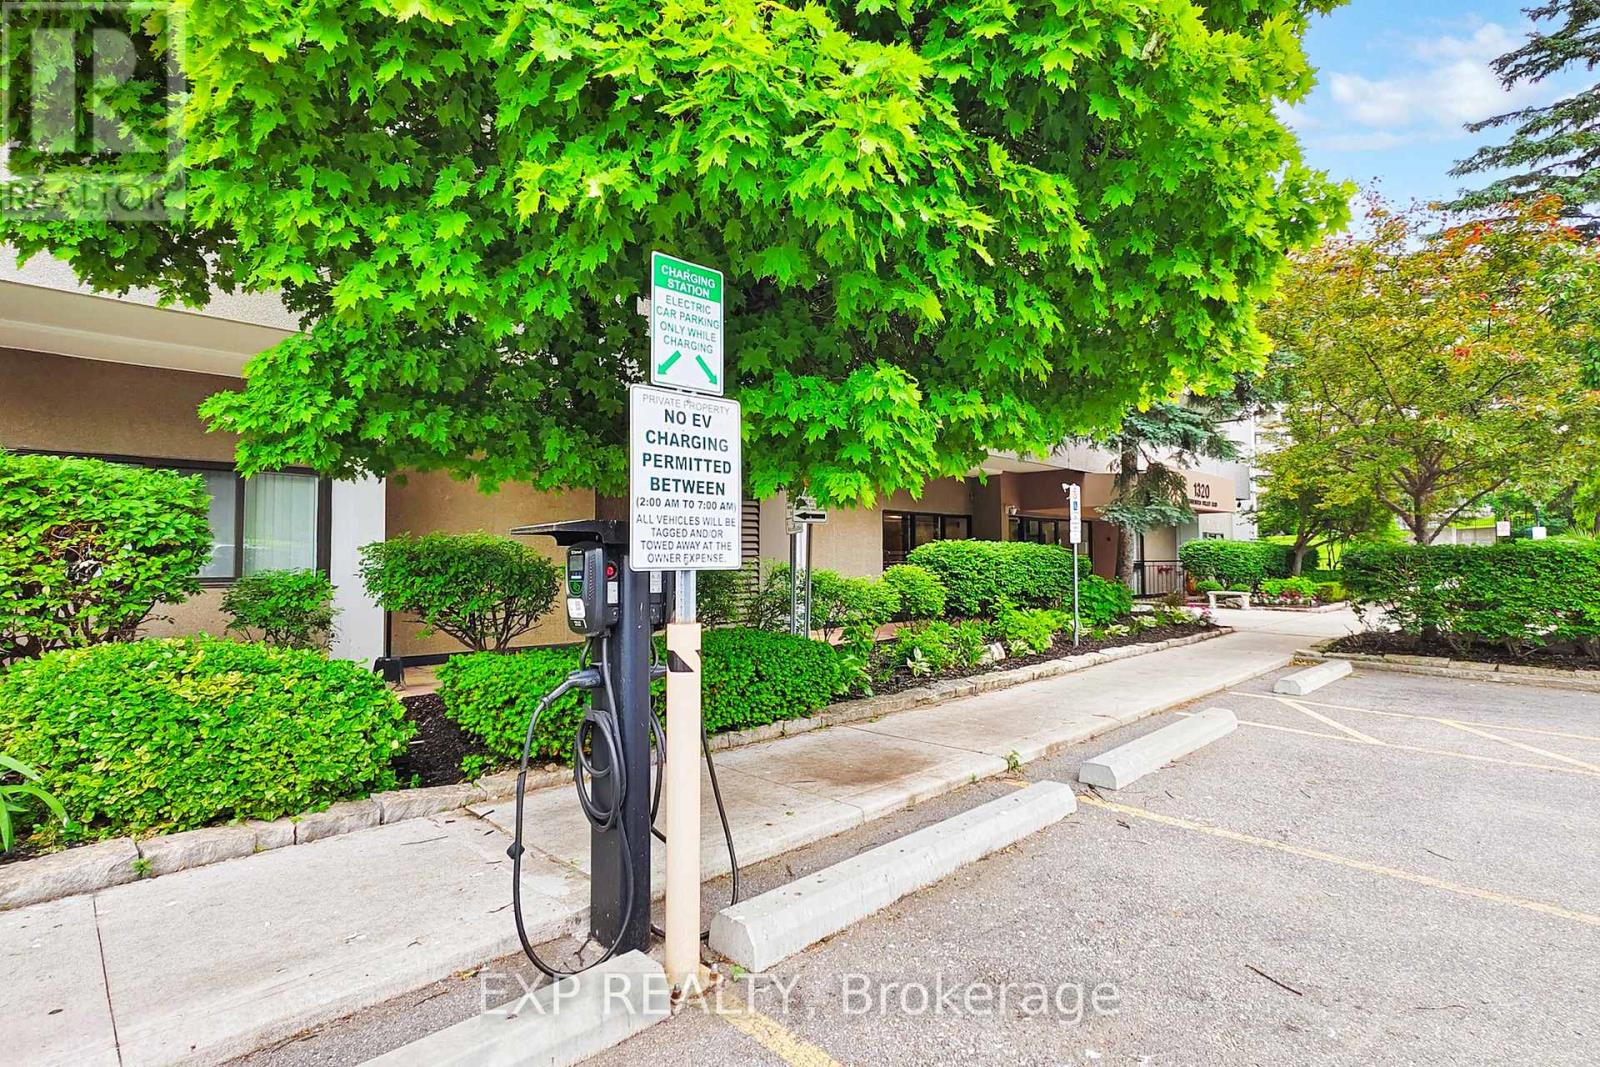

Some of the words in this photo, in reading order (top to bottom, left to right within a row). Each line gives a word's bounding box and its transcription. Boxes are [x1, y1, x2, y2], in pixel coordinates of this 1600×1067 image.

[661, 264, 716, 289] CHARGING
[667, 278, 710, 299] STATION
[665, 294, 711, 315] ELECTRIC
[656, 305, 676, 319] CAR
[679, 311, 720, 330] PARKING
[660, 320, 685, 334] ONLY
[687, 326, 717, 343] WHILE
[663, 334, 713, 354] CHARGING
[642, 393, 681, 408] PRIVATE
[683, 399, 730, 416] PROPERTY
[664, 408, 687, 425] NO
[692, 413, 712, 428] EV
[645, 429, 729, 452] CHARGING
[642, 452, 732, 474] PERMITTED
[650, 476, 726, 496] BETWEEN
[1193, 482, 1210, 499] 1320
[636, 496, 661, 509] (2:00
[664, 498, 680, 508] AM
[682, 499, 695, 509] TO
[697, 500, 717, 511] 7:00
[719, 502, 737, 514] AM)
[636, 514, 654, 524] ALL
[656, 515, 701, 526] VEHICLES
[702, 516, 723, 527] WILL
[724, 517, 736, 528] BE
[650, 527, 689, 538] TAGGED
[640, 540, 675, 551] TOWED
[676, 541, 701, 551] AWAY
[702, 541, 713, 551] AT
[715, 541, 733, 552] THE
[647, 553, 681, 564] OWNER
